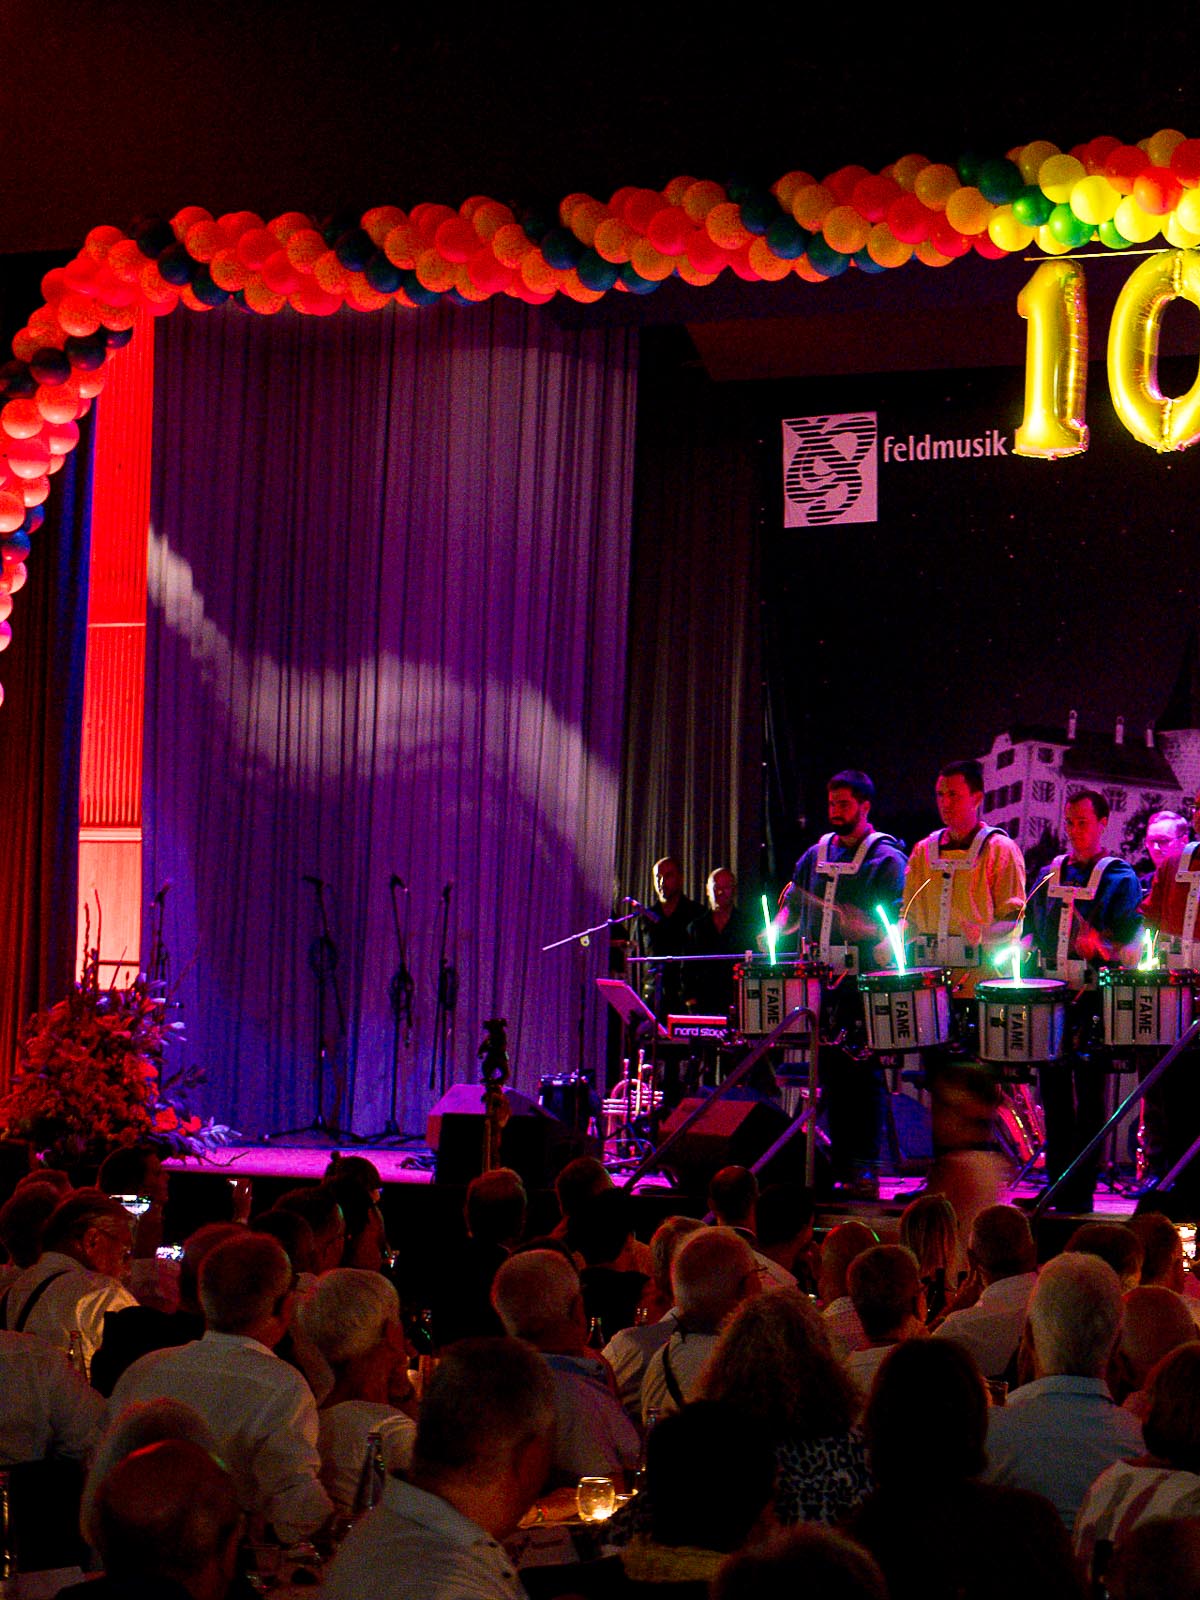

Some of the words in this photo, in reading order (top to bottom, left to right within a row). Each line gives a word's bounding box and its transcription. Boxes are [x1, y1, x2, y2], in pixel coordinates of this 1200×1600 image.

[883, 430, 1009, 463] feldmusik
[766, 987, 780, 1026] FAME
[895, 1001, 911, 1040] FAME
[1139, 995, 1153, 1034] FAME
[674, 1027, 699, 1037] nord
